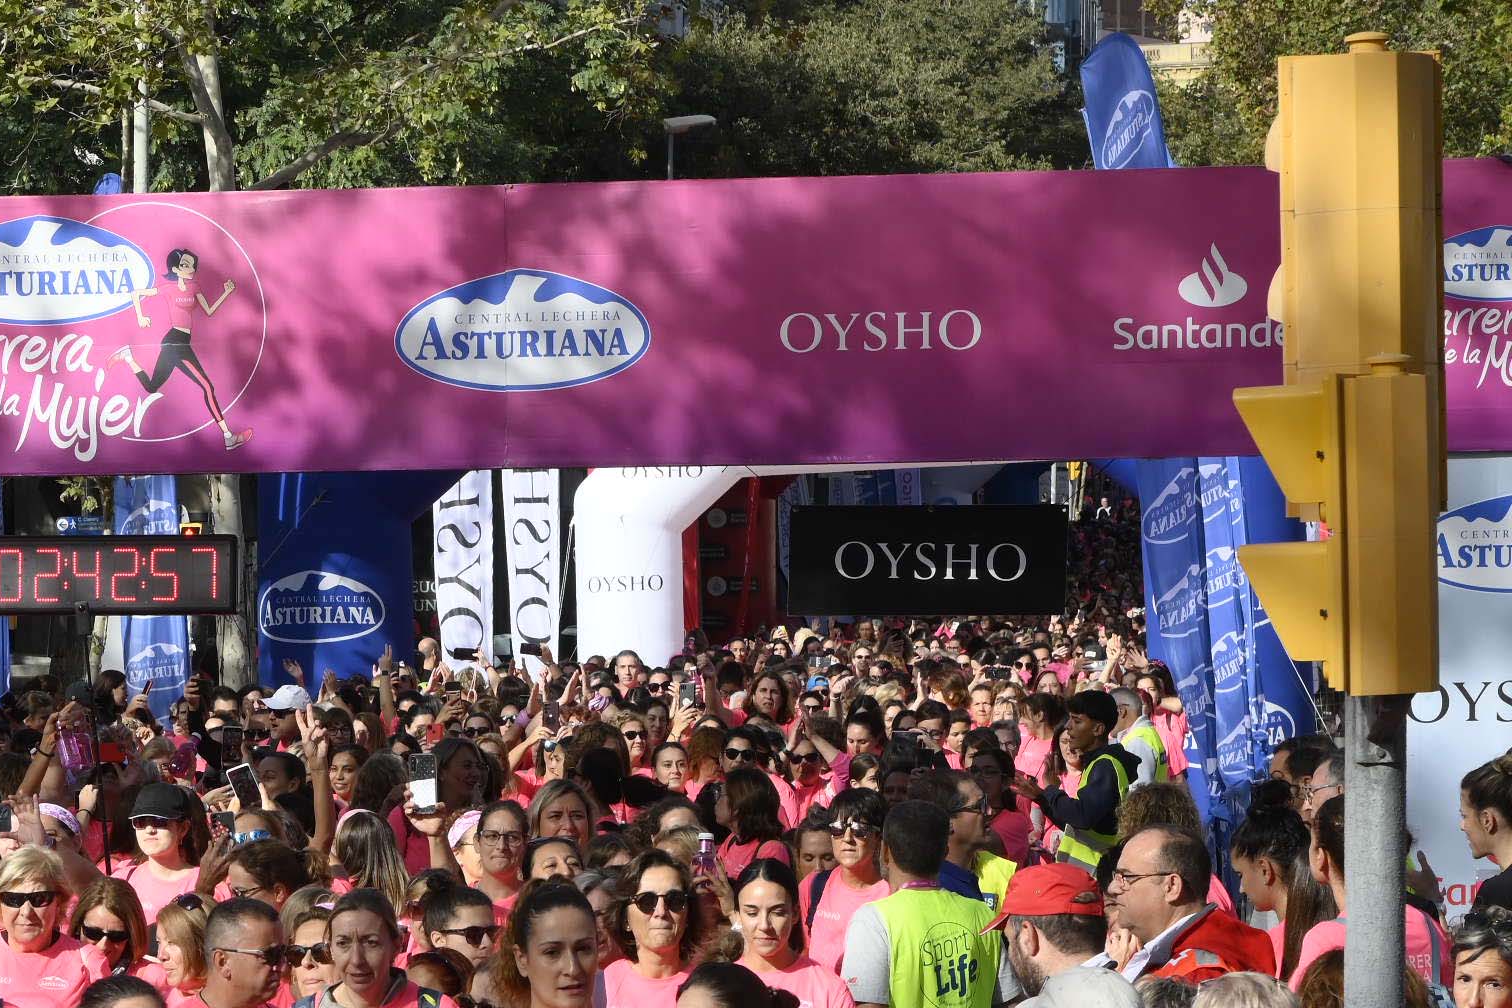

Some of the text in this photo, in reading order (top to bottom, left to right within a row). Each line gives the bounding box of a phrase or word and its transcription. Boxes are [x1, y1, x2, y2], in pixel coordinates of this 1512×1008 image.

[58, 251, 129, 264] LECHERA
[454, 309, 622, 325] CENTRAL LECHERA
[778, 309, 983, 354] OYSHO
[1113, 317, 1284, 351] Santande
[414, 317, 631, 361] ASTURIANA
[1462, 335, 1481, 364] la
[15, 369, 164, 462] Mujer
[835, 541, 1027, 583] OYSHO
[588, 574, 664, 594] OYSHO
[263, 599, 376, 627] ASTURIANA
[923, 930, 970, 966] Sport
[934, 954, 978, 997] Life
